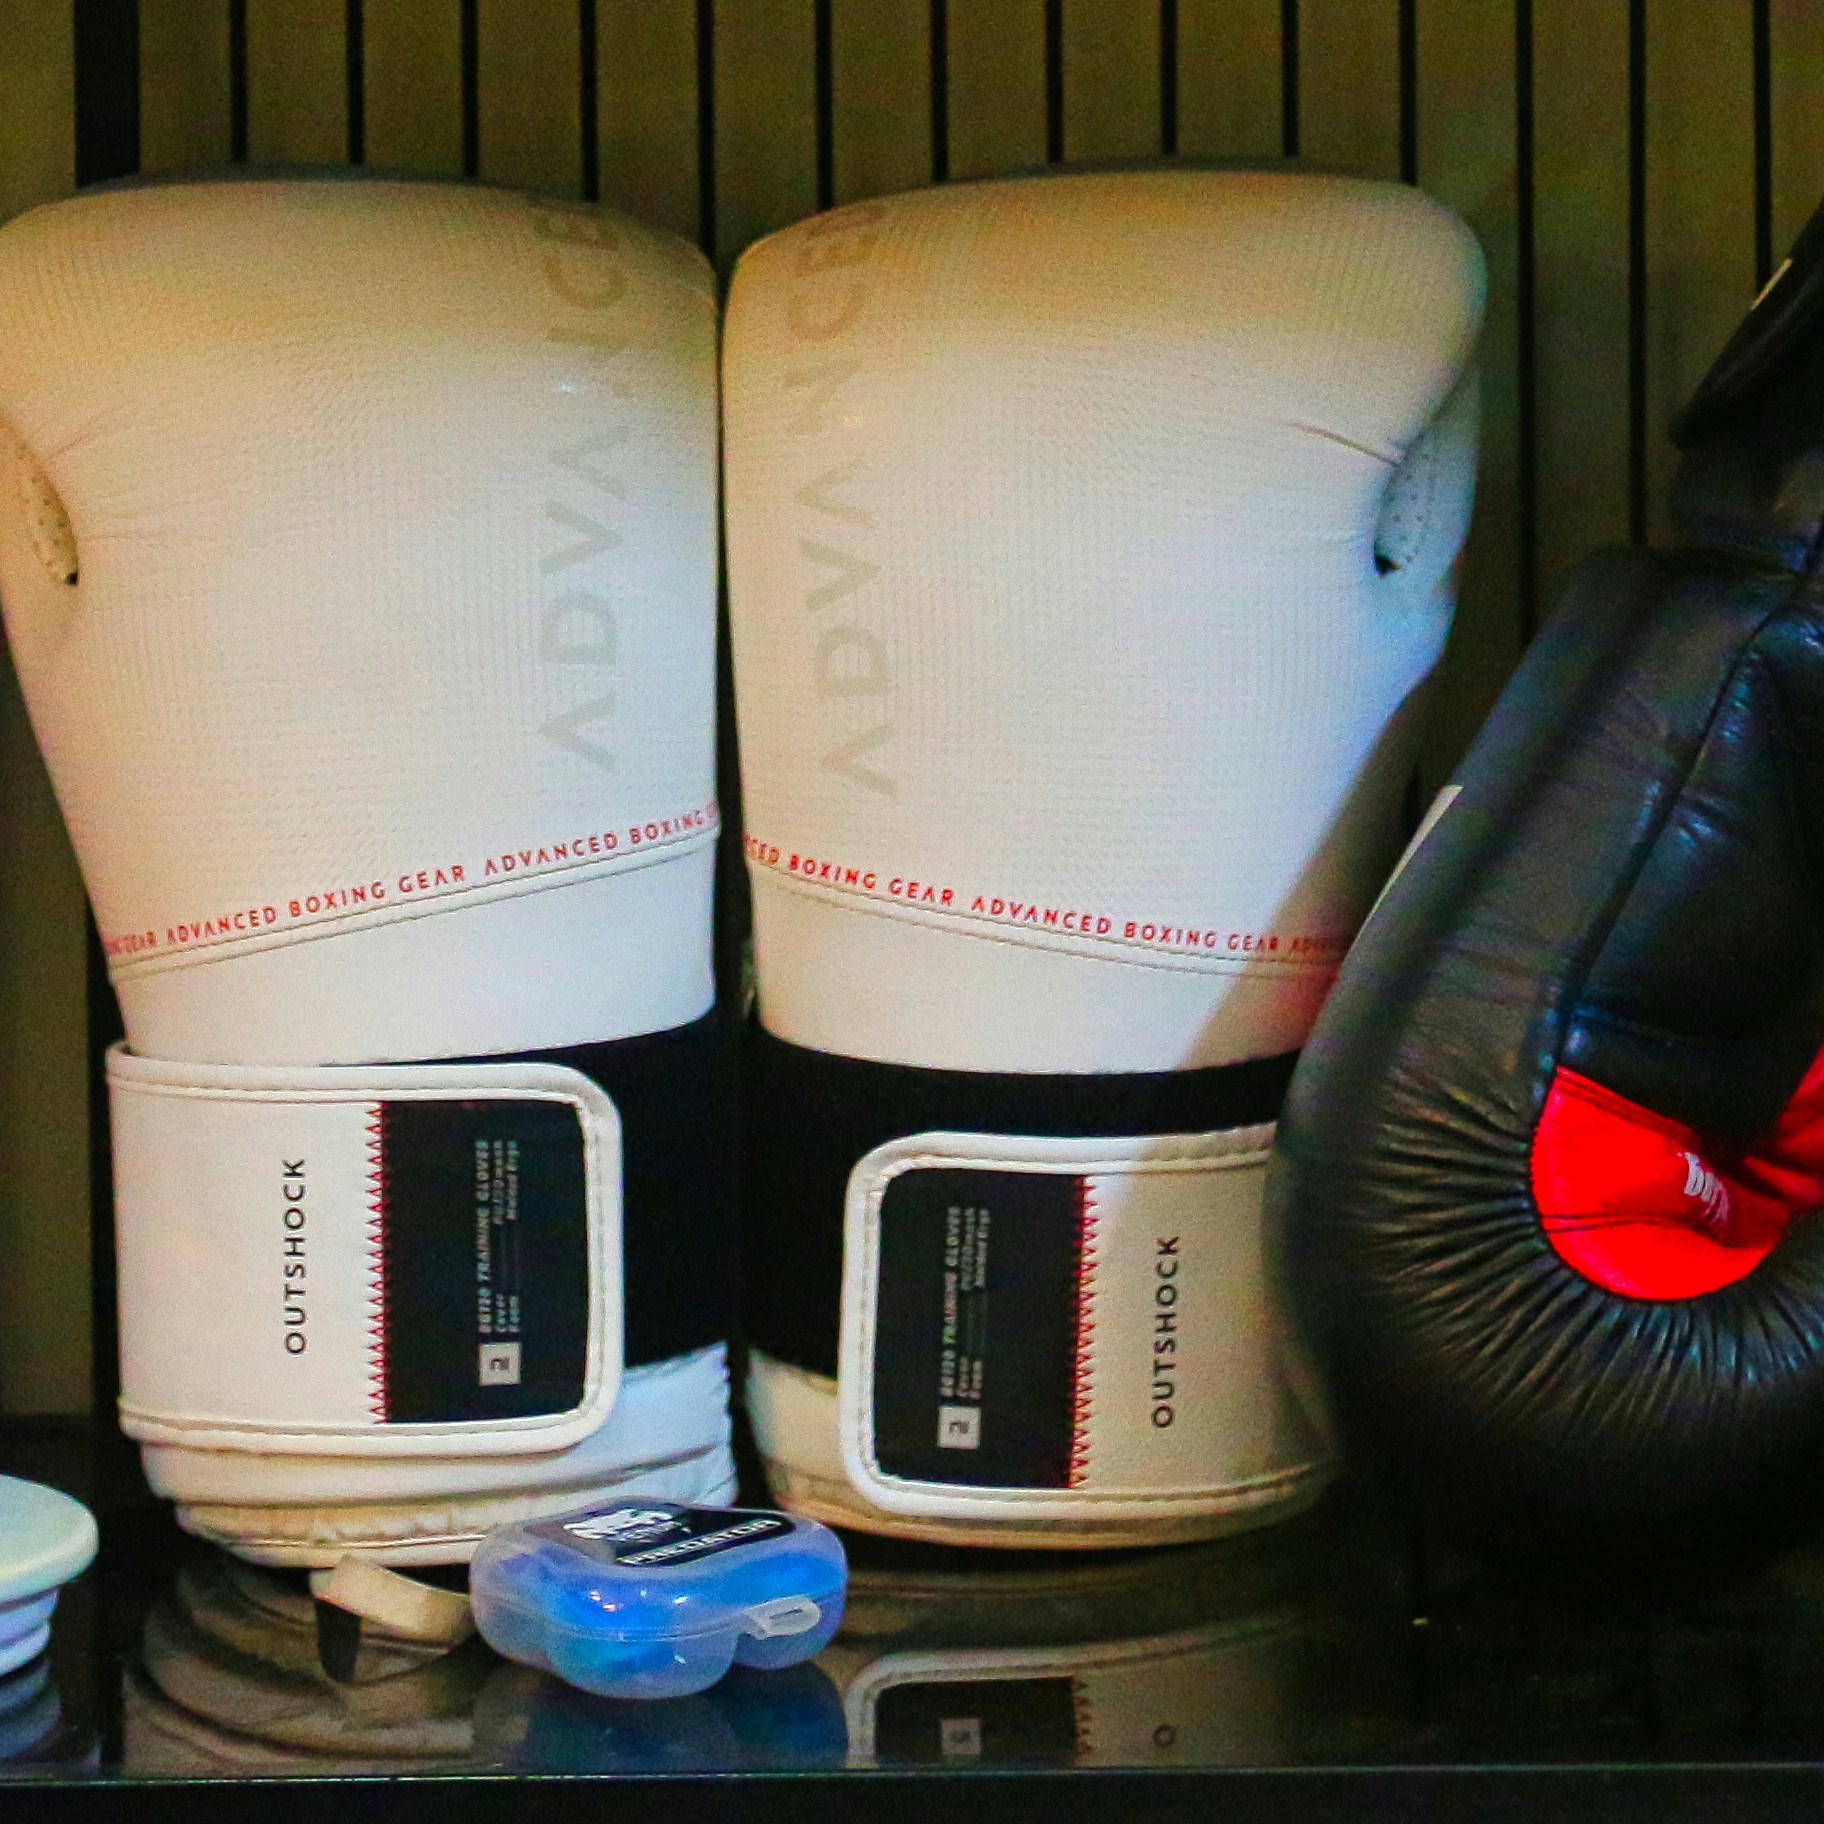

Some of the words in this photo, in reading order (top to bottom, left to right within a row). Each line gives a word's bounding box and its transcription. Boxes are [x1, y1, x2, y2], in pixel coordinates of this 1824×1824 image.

[166, 905, 278, 945] ADVANCED
[287, 879, 387, 919] BOXING
[397, 863, 466, 894] GEAR
[483, 831, 619, 876] ADVANCED
[628, 808, 704, 846] BOXING
[788, 853, 877, 891] BOXING
[888, 876, 955, 907] GEAR
[970, 894, 1111, 936] ADVANCED
[1123, 920, 1217, 950] BOXING
[1227, 933, 1279, 953] GEAR
[282, 1158, 308, 1356] OUTSHOCK
[1150, 1235, 1181, 1429] OUTSHOCK
